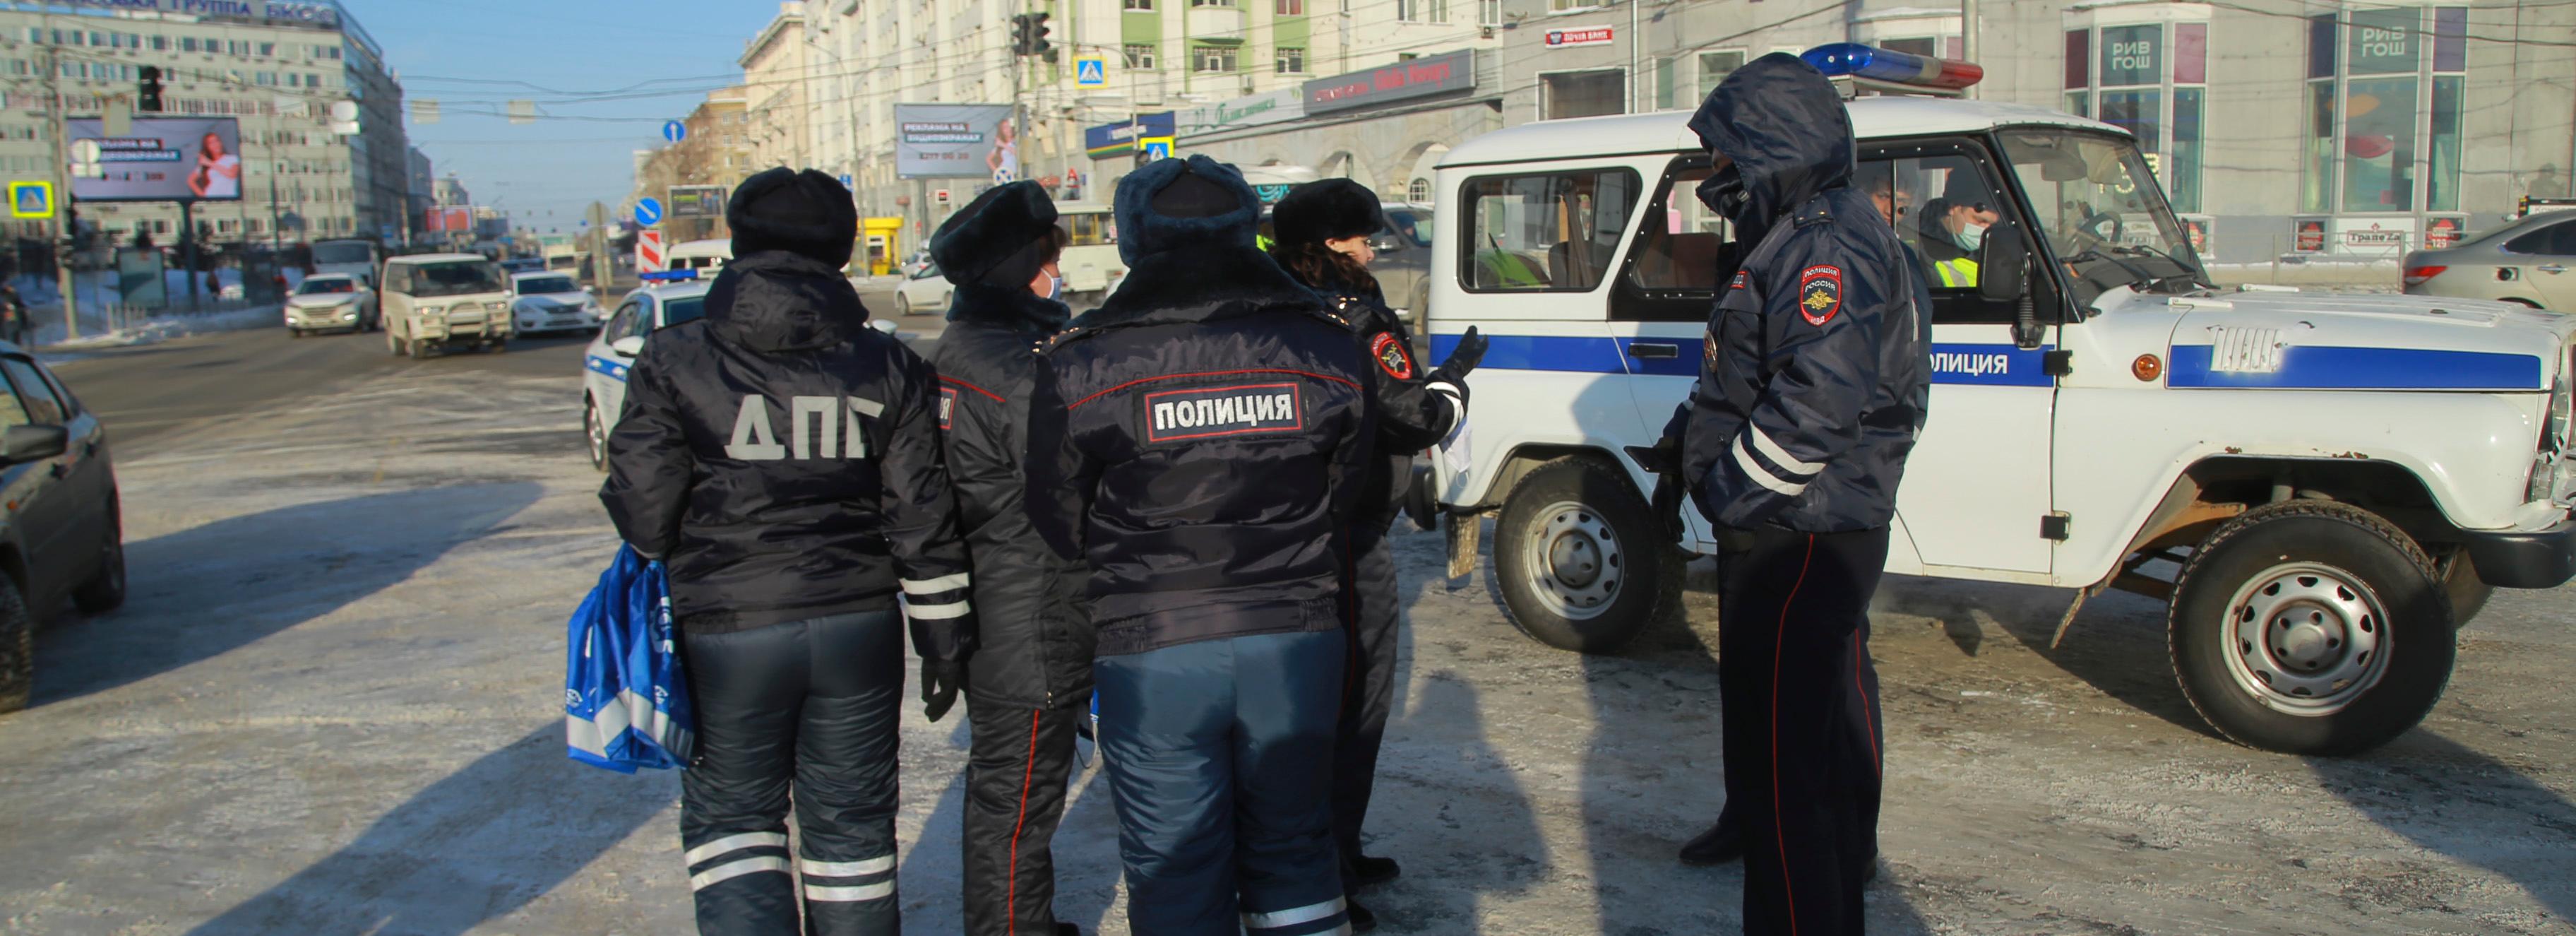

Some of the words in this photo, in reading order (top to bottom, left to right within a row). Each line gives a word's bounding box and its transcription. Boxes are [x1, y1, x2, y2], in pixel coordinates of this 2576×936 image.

[172, 0, 252, 16] ГРУППА
[1587, 30, 1608, 40] БАНК
[2362, 26, 2405, 42] РИВ
[2113, 41, 2150, 56] РИВ
[2362, 42, 2405, 57] ГОШ
[2113, 55, 2150, 70] ГОШ
[1805, 267, 1837, 278] ПОЛИЦИЯ
[1805, 280, 1836, 292] РОССИЯ
[1929, 353, 2008, 377] ЛИЦИЯ
[1154, 393, 1293, 430] ПОЛИЦИЯ
